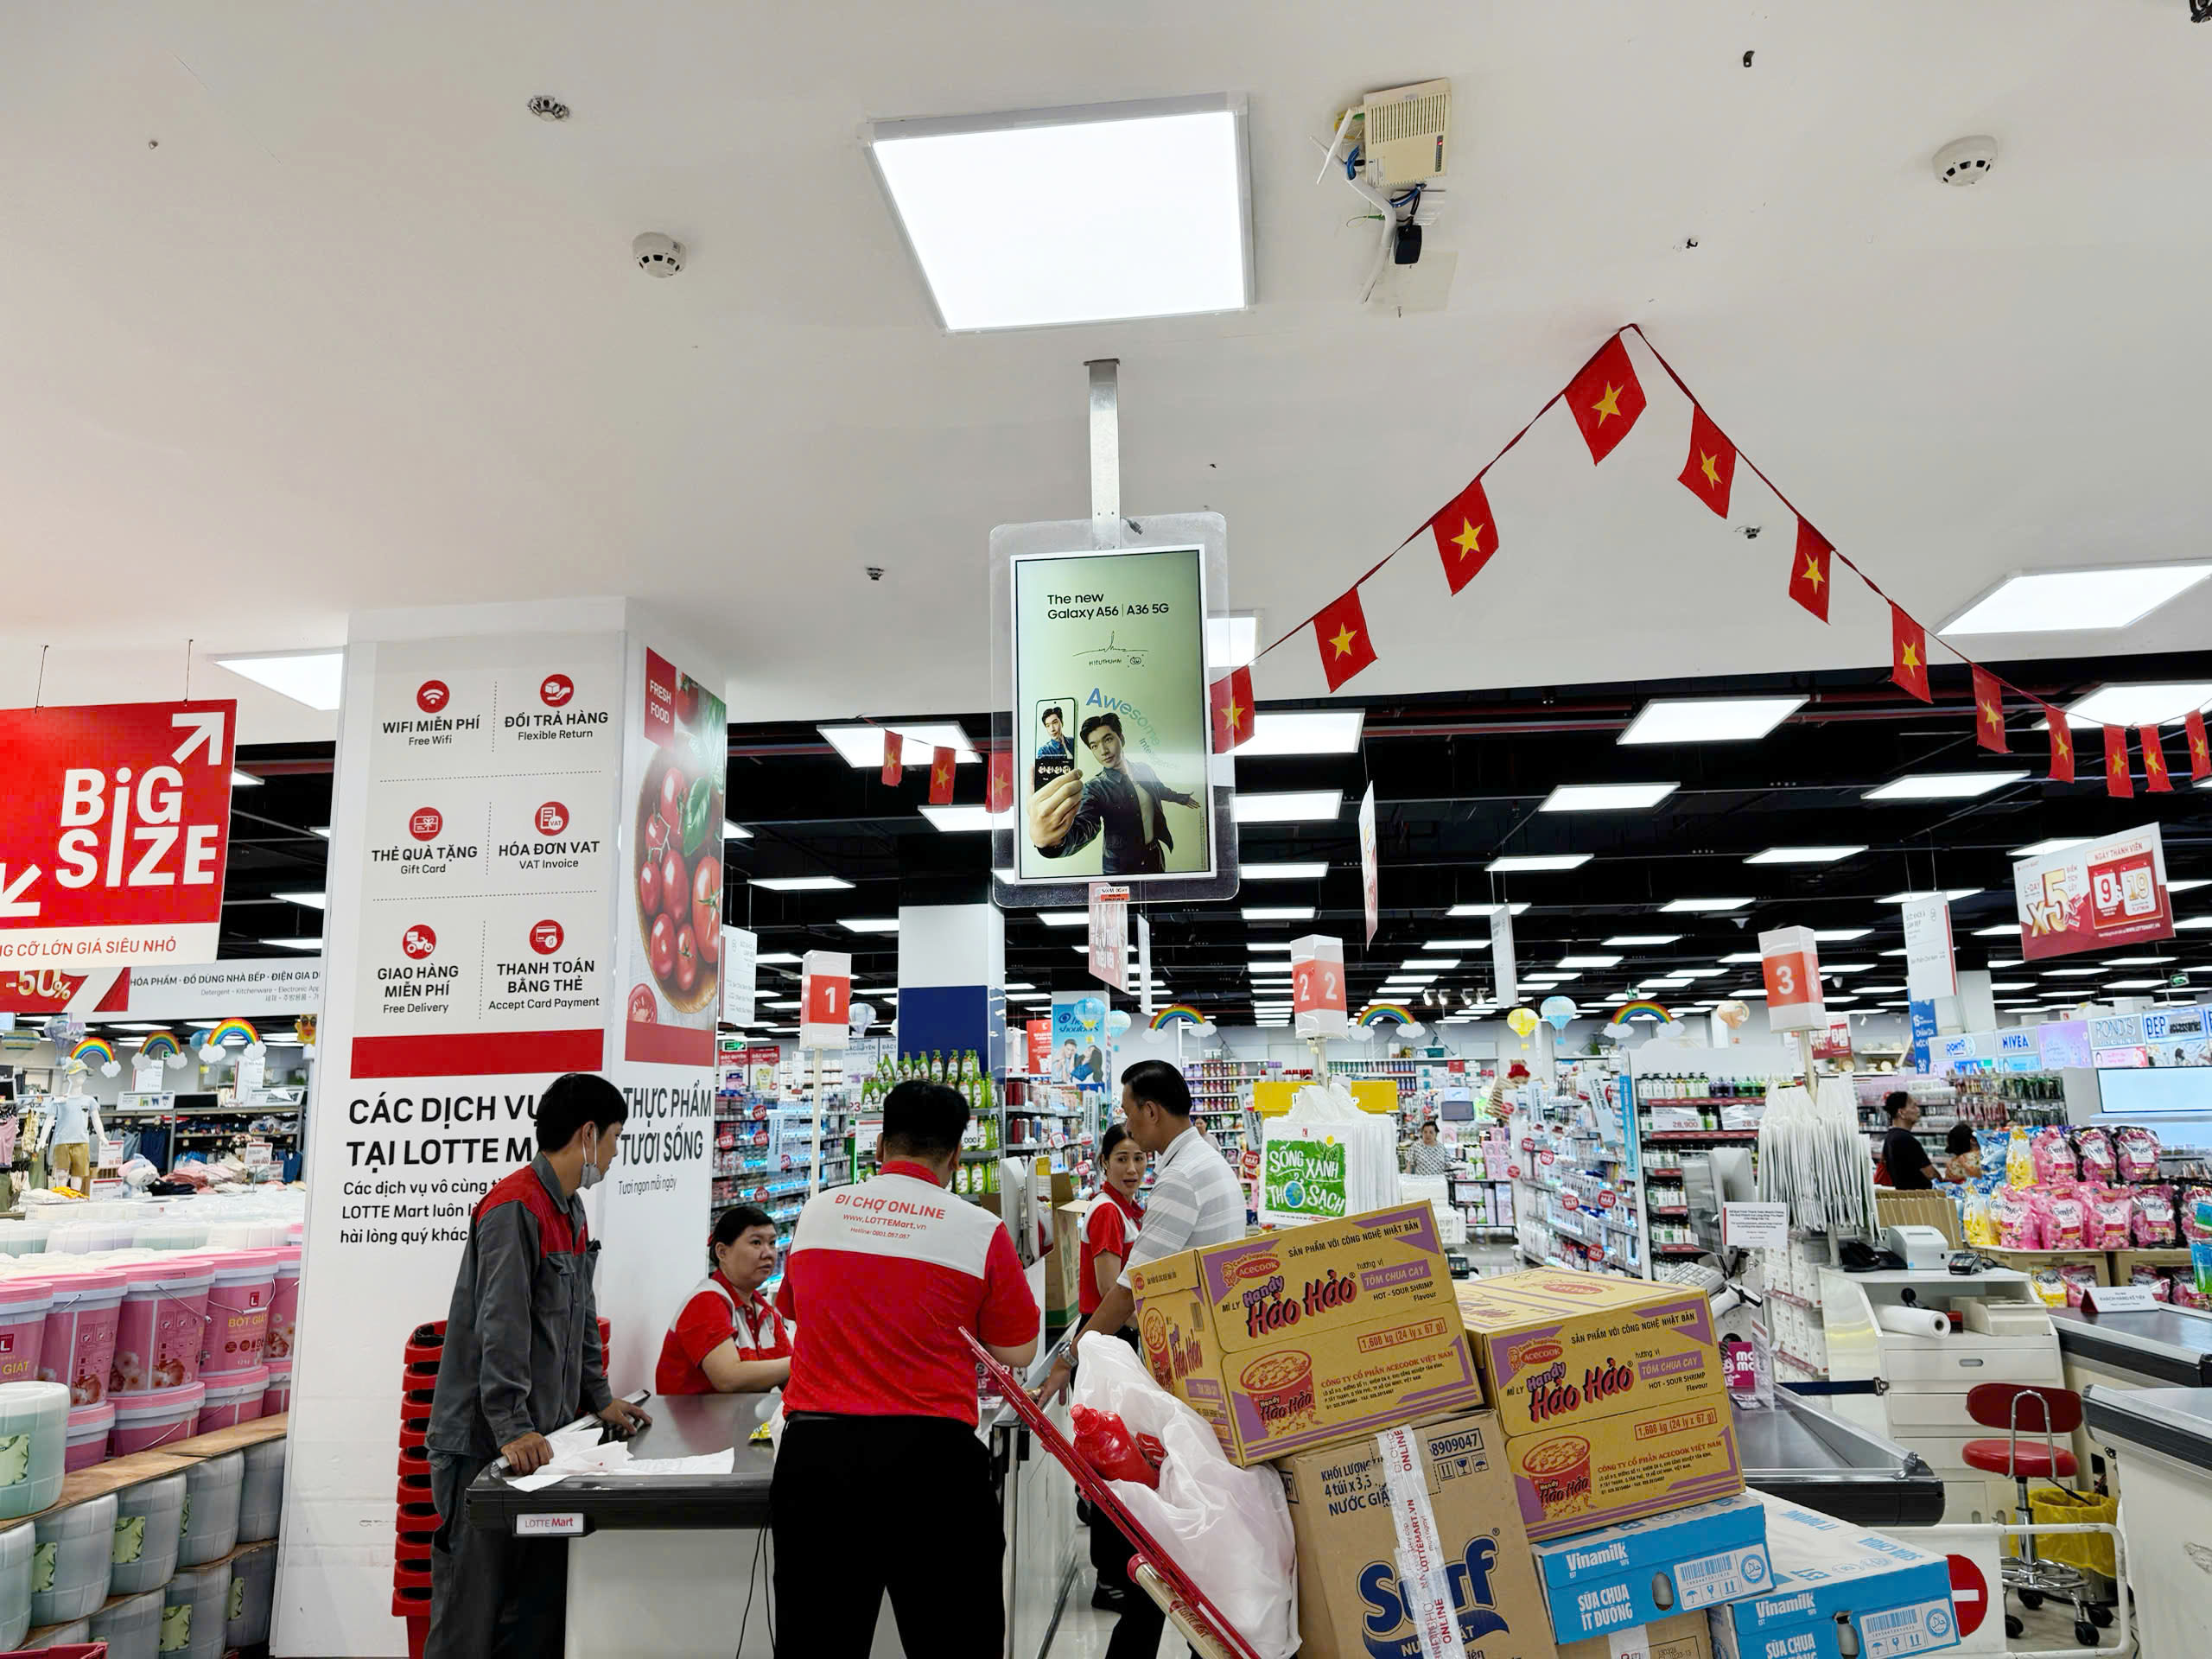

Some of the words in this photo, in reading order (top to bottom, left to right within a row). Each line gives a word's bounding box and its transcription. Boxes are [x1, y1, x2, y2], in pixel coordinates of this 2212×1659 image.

[1047, 594, 1071, 605] The
[1075, 594, 1104, 603] new
[1047, 608, 1094, 620] Galaxy
[1096, 607, 1119, 617] A56
[1127, 605, 1149, 615] A36
[1152, 603, 1169, 613] 5G
[650, 679, 671, 705] FRESH
[505, 711, 530, 728] ĐỔI
[534, 710, 563, 727] TRẢ
[566, 709, 608, 726] HÀNG
[651, 702, 670, 723] FOOD
[383, 719, 415, 734] WIFI
[416, 715, 454, 733] MIỄN
[456, 715, 480, 730] PHÍ
[518, 730, 556, 741] Flexible
[559, 729, 594, 740] Return
[409, 736, 430, 747] Free
[432, 734, 453, 746] Wifi
[372, 844, 400, 861] THẺ
[403, 845, 435, 861] QUÀ
[436, 843, 478, 862] TẶNG
[499, 842, 530, 856] HÓA
[534, 841, 567, 855] ĐƠN
[570, 840, 601, 854] VAT
[400, 864, 420, 875] Gift
[423, 863, 446, 874] Card
[519, 860, 540, 870] VAT
[543, 858, 579, 869] Invoice
[2101, 878, 2112, 903] 9
[2126, 873, 2149, 901] 19
[17, 940, 40, 957] CỠ
[42, 938, 74, 956] LỚN
[77, 937, 103, 955] GIÁ
[105, 936, 139, 954] SIÊU
[143, 935, 176, 953] NHỎ
[378, 967, 413, 981] GIAO
[416, 963, 459, 980] HÀNG
[497, 963, 550, 977] THANH
[553, 957, 595, 975] TOÁN
[130, 975, 149, 987] HÓA
[150, 973, 177, 986] PHẨM
[199, 972, 225, 984] DÙNG
[226, 971, 246, 983] NHÀ
[295, 971, 310, 980] GIA
[385, 981, 422, 999] MIỄN
[425, 980, 450, 997] PHÍ
[507, 977, 550, 995] BẰNG
[553, 975, 583, 992] THẺ
[1300, 974, 1310, 1002] 2
[1324, 971, 1338, 1001] 2
[1776, 965, 1795, 995] 3
[383, 1003, 404, 1014] Free
[408, 1002, 448, 1015] Delivery
[488, 1000, 524, 1012] Accept
[527, 998, 551, 1010] Card
[554, 997, 600, 1010] Payment
[824, 987, 836, 1014] 1
[2002, 1034, 2030, 1050] NIVEA
[349, 1091, 413, 1124] CÁC
[421, 1096, 496, 1128] DỊCH
[623, 1085, 668, 1126] THỰC
[671, 1079, 711, 1119] PHẨM
[346, 1139, 395, 1173] TẠI
[404, 1137, 499, 1165] LOTTE
[621, 1133, 659, 1166] TƯƠI
[664, 1123, 702, 1161] SỐNG
[1269, 1141, 1304, 1173] SỐNG
[1306, 1158, 1338, 1179] XANH
[343, 1179, 378, 1195] Các
[379, 1179, 408, 1196] dịch
[410, 1184, 427, 1196] vụ
[430, 1180, 448, 1193] vô
[452, 1179, 487, 1197] cùng
[835, 1193, 850, 1205] ĐI
[852, 1196, 887, 1214] CHỢ
[887, 1200, 946, 1220] ONLINE
[1306, 1185, 1345, 1214] SẠCH
[342, 1205, 390, 1219] LOTTE
[394, 1205, 429, 1218] Mart
[432, 1203, 465, 1217] luôn
[842, 1213, 927, 1230] www.LOTTEMart.vn
[340, 1228, 362, 1244] hài
[366, 1228, 397, 1246] lòng
[400, 1226, 428, 1246] quý
[432, 1225, 468, 1242] khác
[1288, 1245, 1304, 1258] SẢN
[1306, 1240, 1326, 1254] PHẨM
[1327, 1236, 1339, 1249] VỚI
[1342, 1233, 1361, 1246] CÔNG
[1363, 1229, 1382, 1242] NGHỆ
[1383, 1224, 1402, 1236] NHẬT
[1404, 1221, 1419, 1232] BẢN
[1364, 1275, 1384, 1287] TÔM
[1385, 1270, 1407, 1283] CHUA
[1408, 1266, 1425, 1277] CAY
[1243, 1275, 1285, 1307] Handy
[1373, 1292, 1387, 1301] HOT
[1391, 1287, 1408, 1297] SOUR
[1410, 1281, 1434, 1293] SHRIMP
[1414, 1291, 1437, 1302] Flavour
[1246, 1292, 1301, 1338] Hảo
[1303, 1268, 1357, 1317] Hảo
[1320, 1376, 1341, 1389] CÔNG
[1386, 1358, 1420, 1372] ACECOOK
[1438, 1351, 1454, 1360] NAM
[1526, 1361, 1567, 1392] Handy
[1529, 1376, 1581, 1424] Hảo
[1582, 1357, 1635, 1404] Hảo
[1398, 1428, 1412, 1472] ONLINE
[1332, 1479, 1348, 1496] túi
[1328, 1495, 1365, 1516] NƯỚC
[525, 1519, 550, 1529] LOTTE
[551, 1517, 574, 1528] Mart
[1407, 1499, 1430, 1573] LOTTEMART.VN
[1567, 1541, 1628, 1572] Vinamilk
[1577, 1590, 1599, 1612] SỮA
[1600, 1583, 1630, 1606] CHUA
[1755, 1592, 1815, 1619] Vinamilk
[1434, 1598, 1452, 1644] ONLINE
[1581, 1610, 1593, 1632] ÍT
